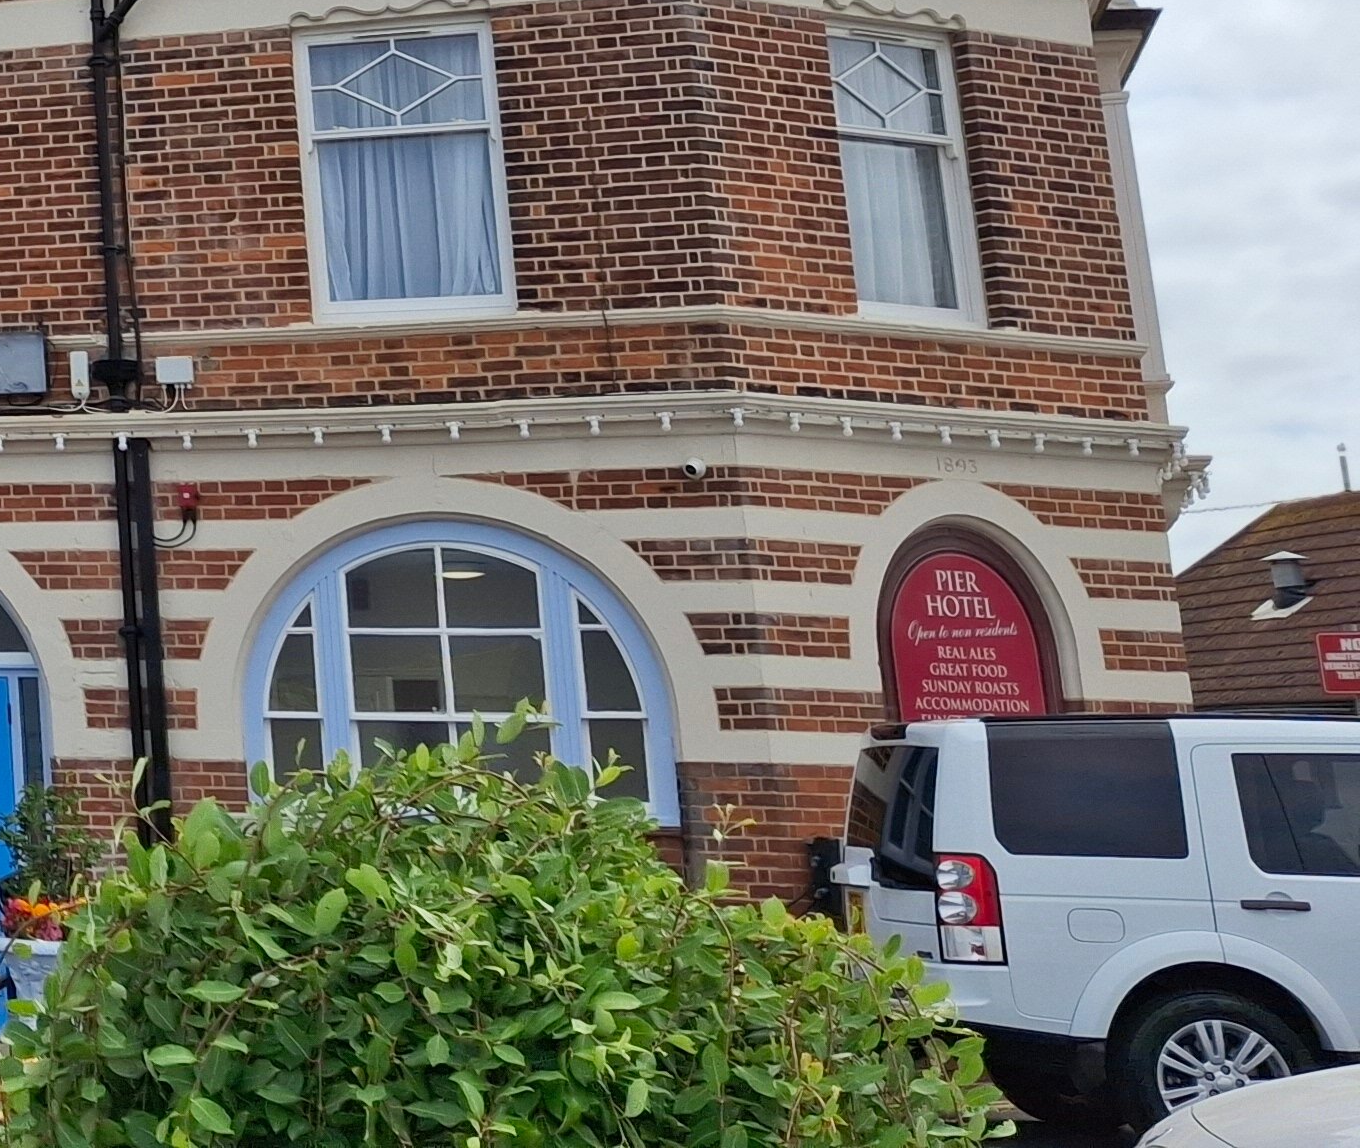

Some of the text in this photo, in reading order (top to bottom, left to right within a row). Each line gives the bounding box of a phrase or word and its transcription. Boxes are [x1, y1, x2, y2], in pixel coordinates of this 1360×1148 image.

[934, 569, 981, 593] PIER
[925, 594, 997, 619] HOTEL
[907, 619, 1018, 647] Open to non residents
[936, 645, 997, 661] REAL ALES
[929, 662, 1008, 678] GREAT FOOD
[921, 679, 1020, 696] SUNDAY ROASTS
[914, 696, 1031, 713] ACCOMMODATION
